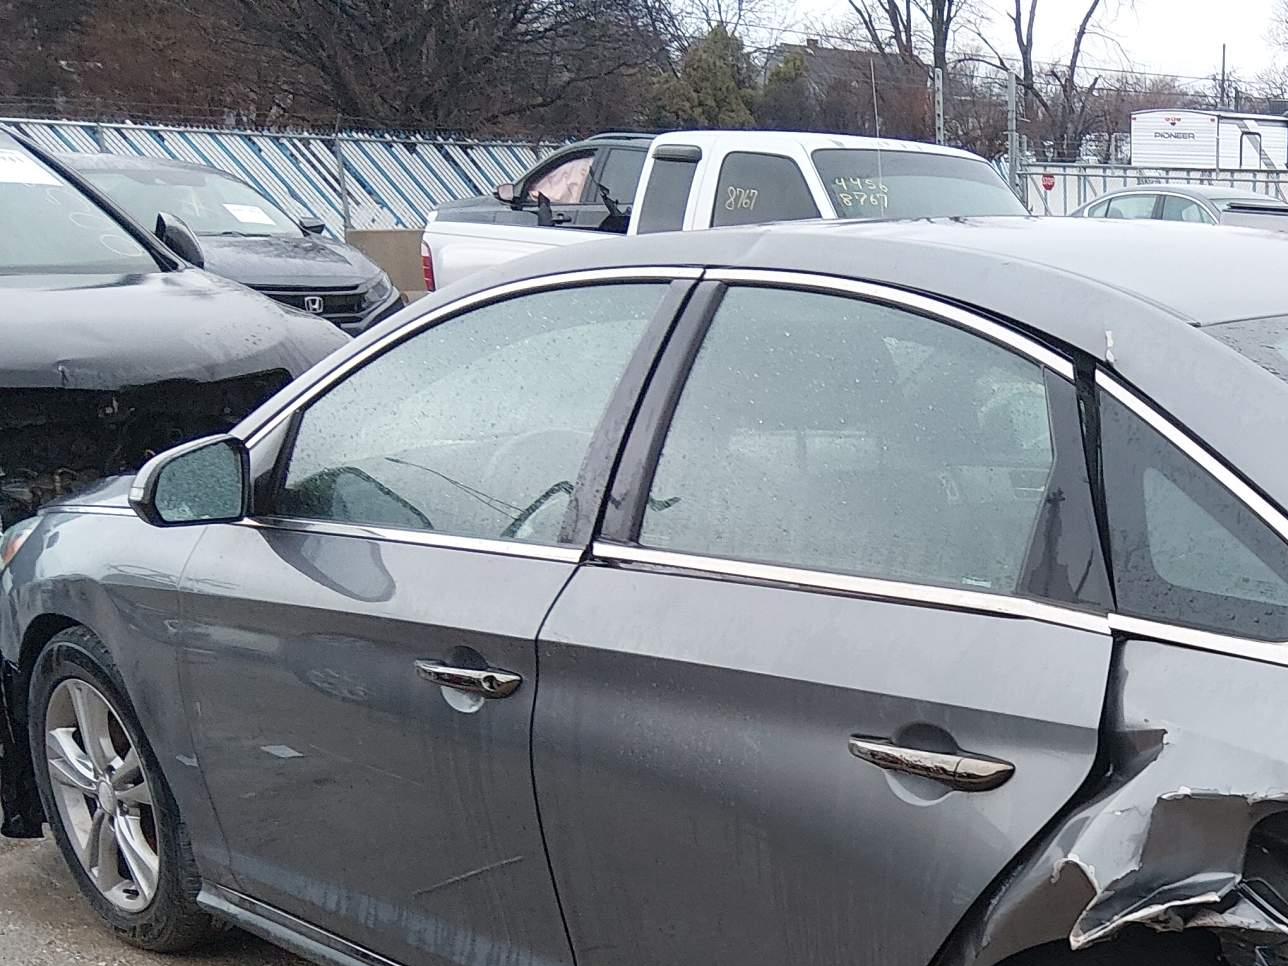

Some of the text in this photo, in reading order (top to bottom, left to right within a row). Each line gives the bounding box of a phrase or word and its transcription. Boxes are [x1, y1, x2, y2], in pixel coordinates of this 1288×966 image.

[1154, 131, 1196, 140] PIONEER
[725, 186, 758, 211] 8767
[840, 191, 888, 209] 8767
